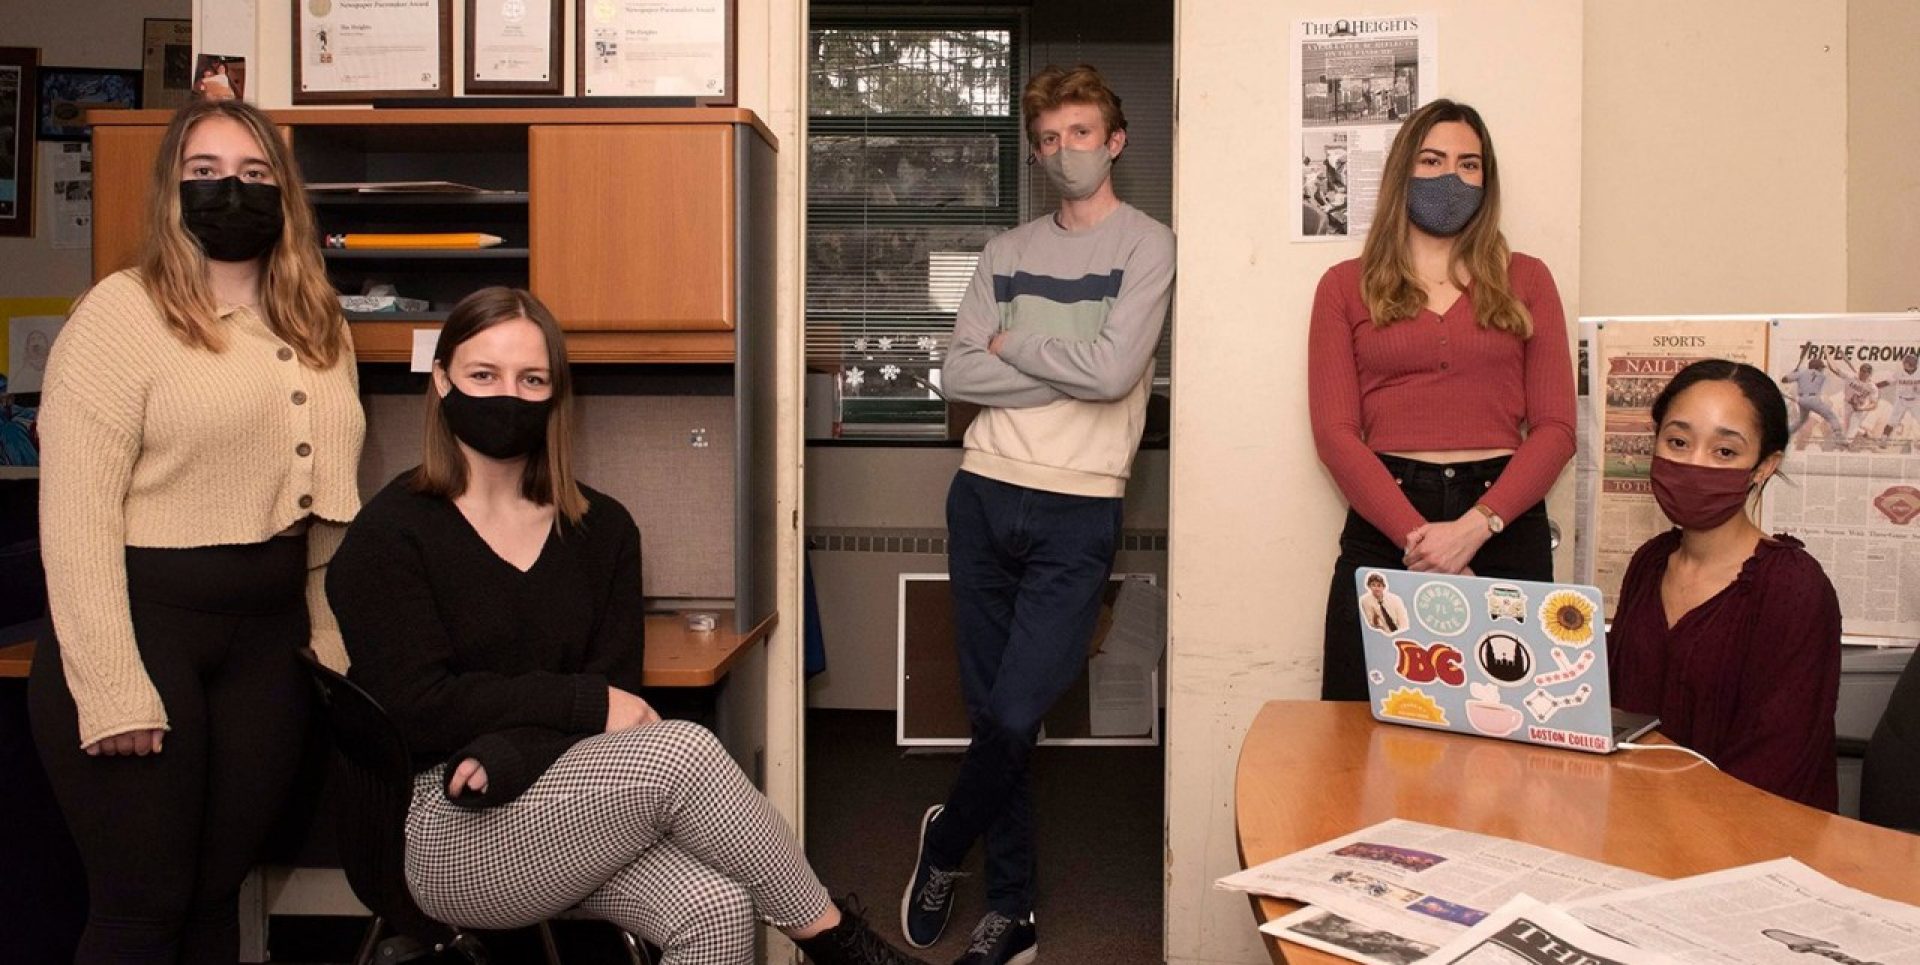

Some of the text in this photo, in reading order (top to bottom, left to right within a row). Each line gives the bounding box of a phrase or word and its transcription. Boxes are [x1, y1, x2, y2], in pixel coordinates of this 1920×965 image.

[1302, 19, 1418, 35] THE HEIGHTS
[1652, 335, 1706, 347] SPORTS
[1799, 344, 1920, 361] TRIPLE CROWN
[1613, 481, 1652, 494] TO TH
[1418, 586, 1465, 612] SUNSHINE
[1425, 614, 1461, 631] STATE
[1395, 640, 1465, 686] BC
[1530, 727, 1606, 750] BOSTON COLLEGE
